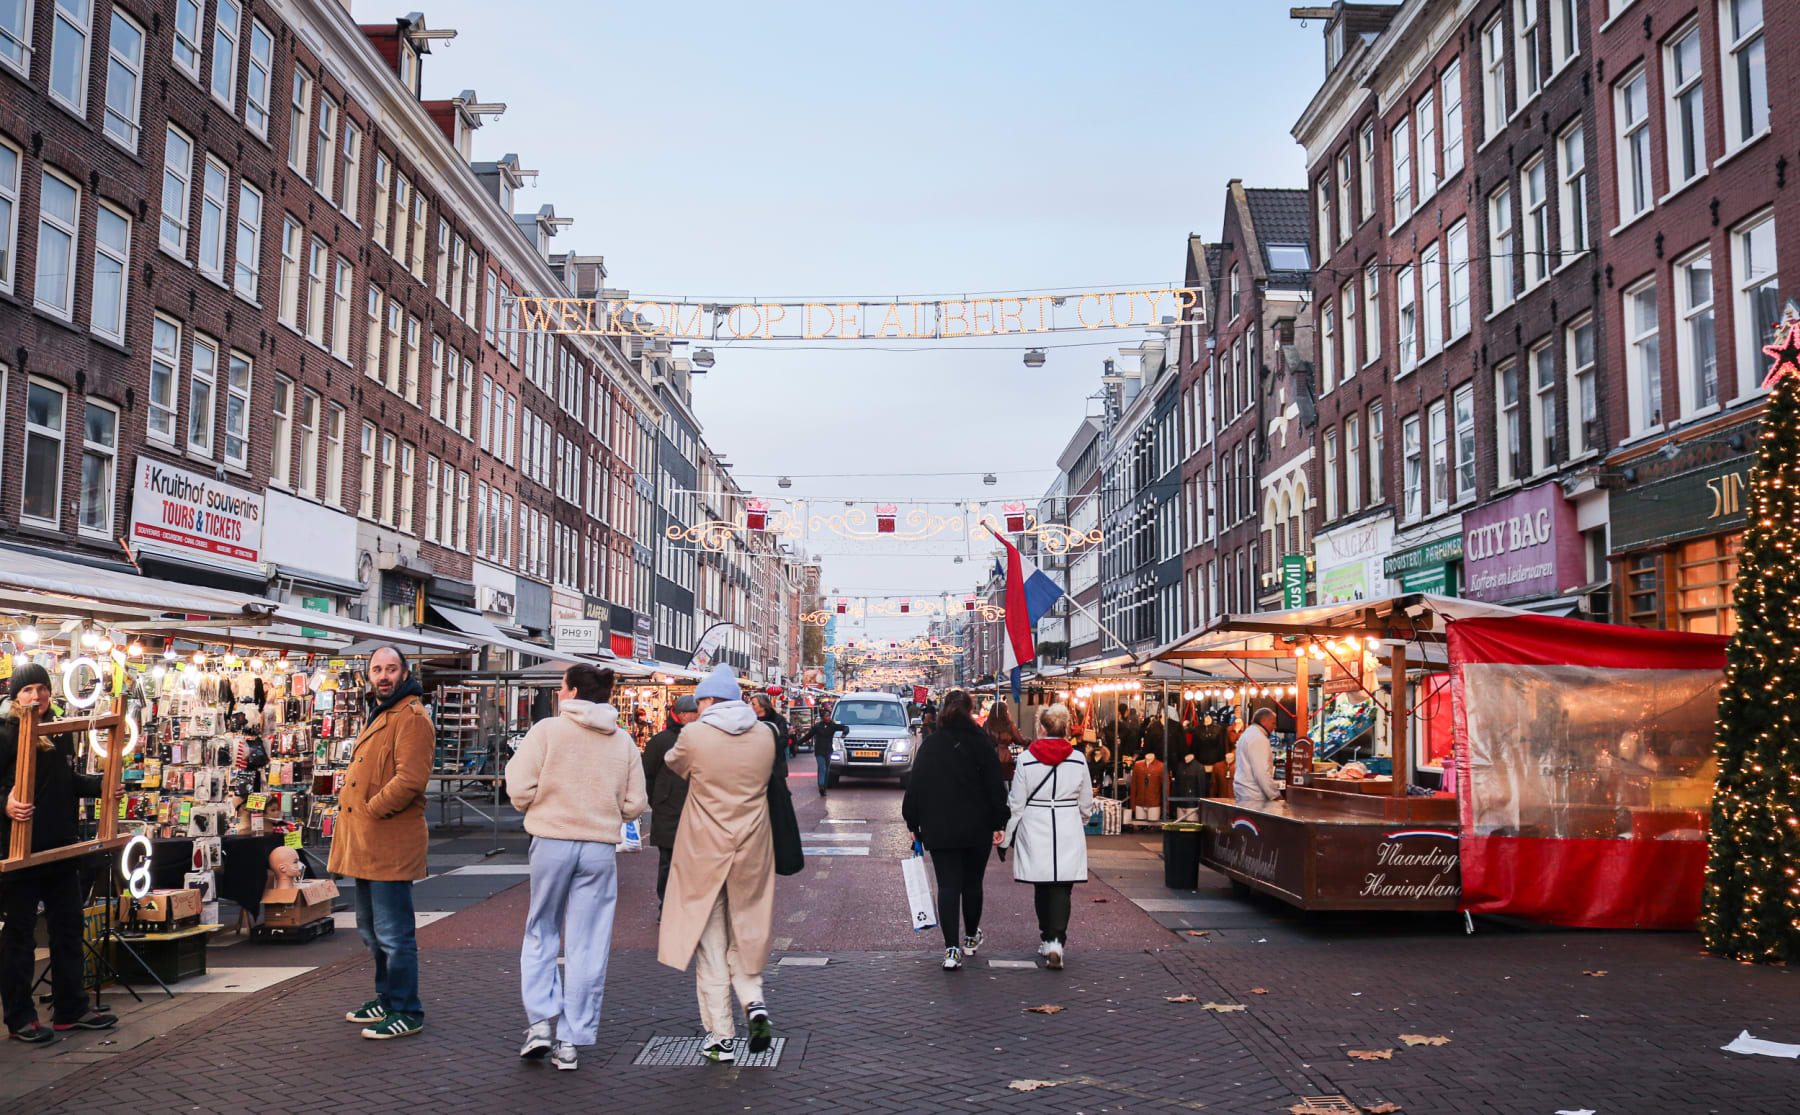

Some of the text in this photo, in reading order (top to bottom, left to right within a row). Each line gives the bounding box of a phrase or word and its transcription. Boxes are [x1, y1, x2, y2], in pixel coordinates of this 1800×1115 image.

[518, 288, 1198, 338] WELKOM OP DE ALBERT CUYP
[151, 466, 259, 521] Kruithof souvenirs
[162, 500, 242, 542] TOURS & TICKETS
[1467, 507, 1552, 562] CITY BAG
[1470, 570, 1498, 598] Koffers
[1498, 574, 1507, 586] en
[1507, 562, 1553, 585] Lederwaren
[584, 629, 592, 638] 91
